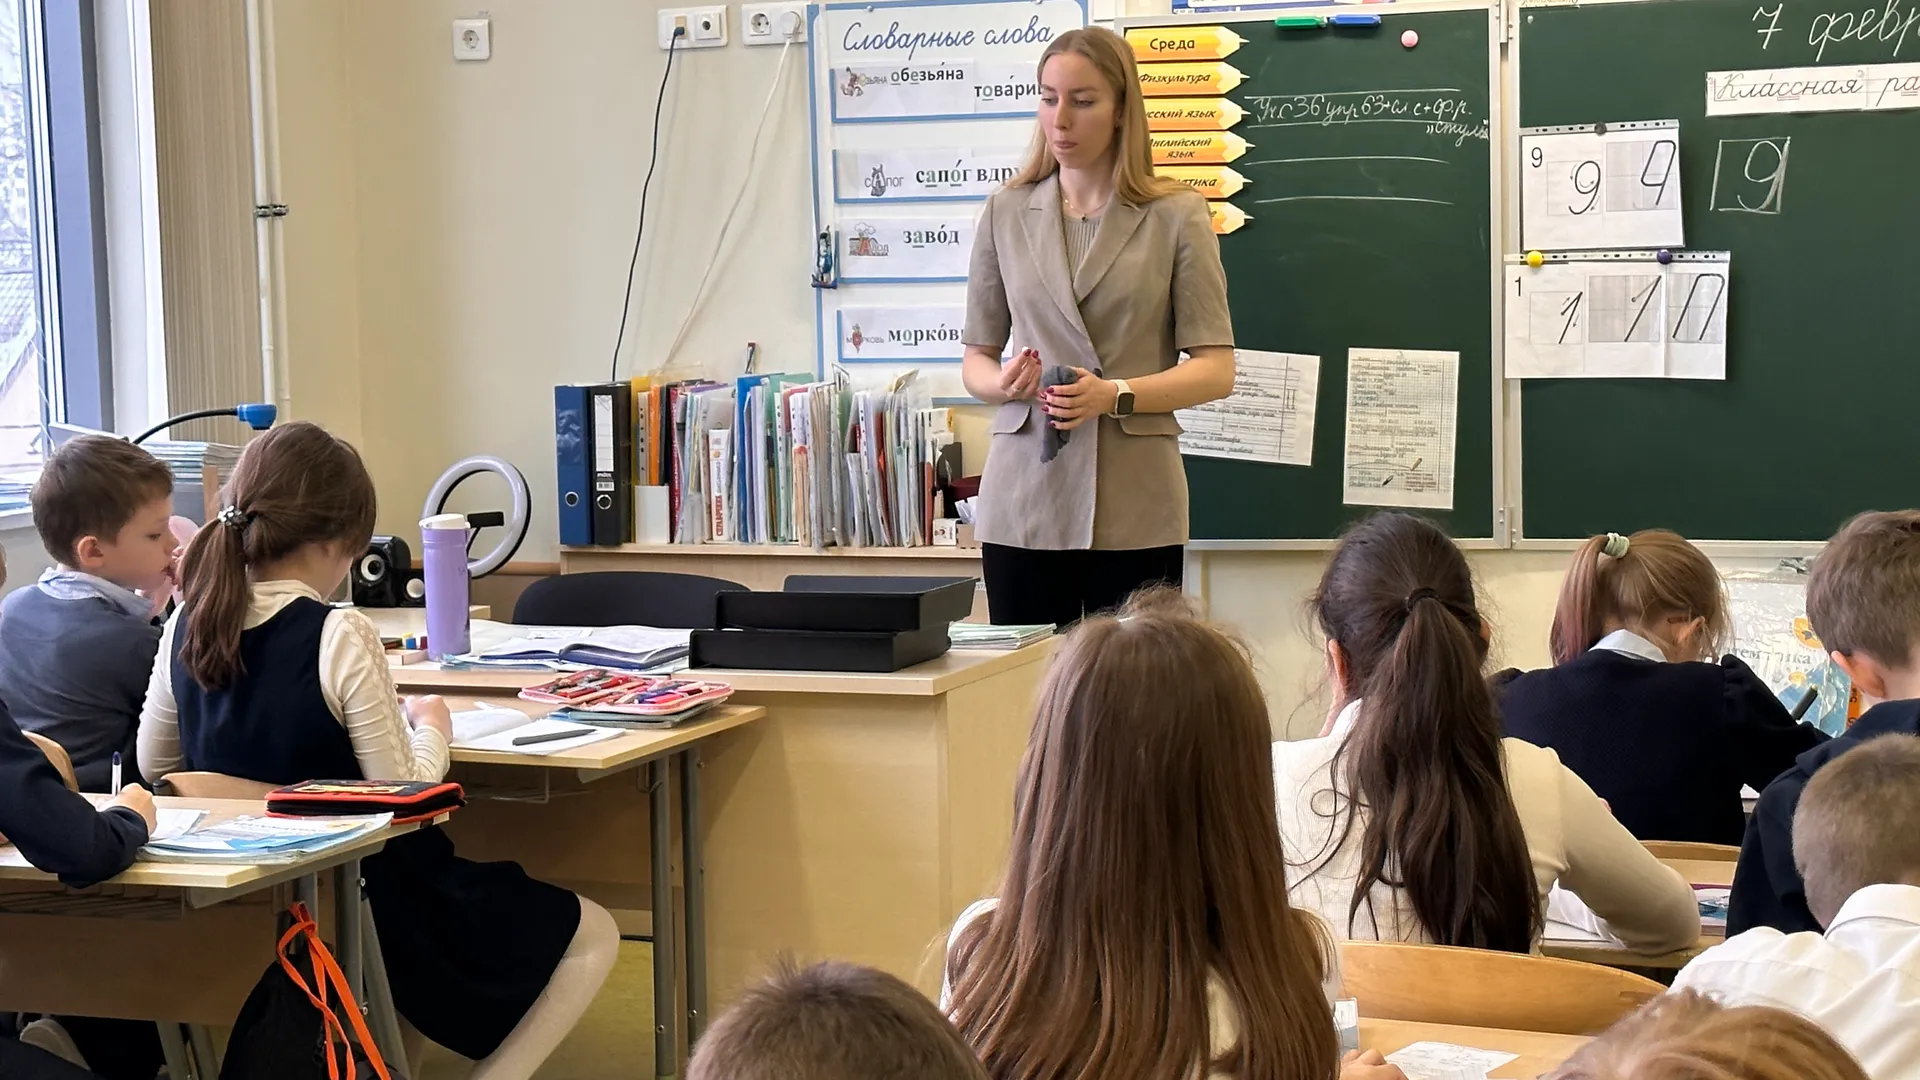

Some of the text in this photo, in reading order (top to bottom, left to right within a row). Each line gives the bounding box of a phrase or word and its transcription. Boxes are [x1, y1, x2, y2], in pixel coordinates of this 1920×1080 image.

[843, 15, 1054, 60] Словарные слова
[1752, 0, 1920, 62] 7 февр
[1149, 38, 1196, 52] Среда
[1139, 73, 1212, 85] Физкультура
[1146, 109, 1217, 118] сский язык
[1531, 146, 1543, 168] 9
[976, 167, 1020, 187] вдр
[1736, 140, 1785, 212] 9
[1568, 160, 1601, 215] 9
[1514, 276, 1523, 297] 1
[1559, 290, 1583, 344] 1
